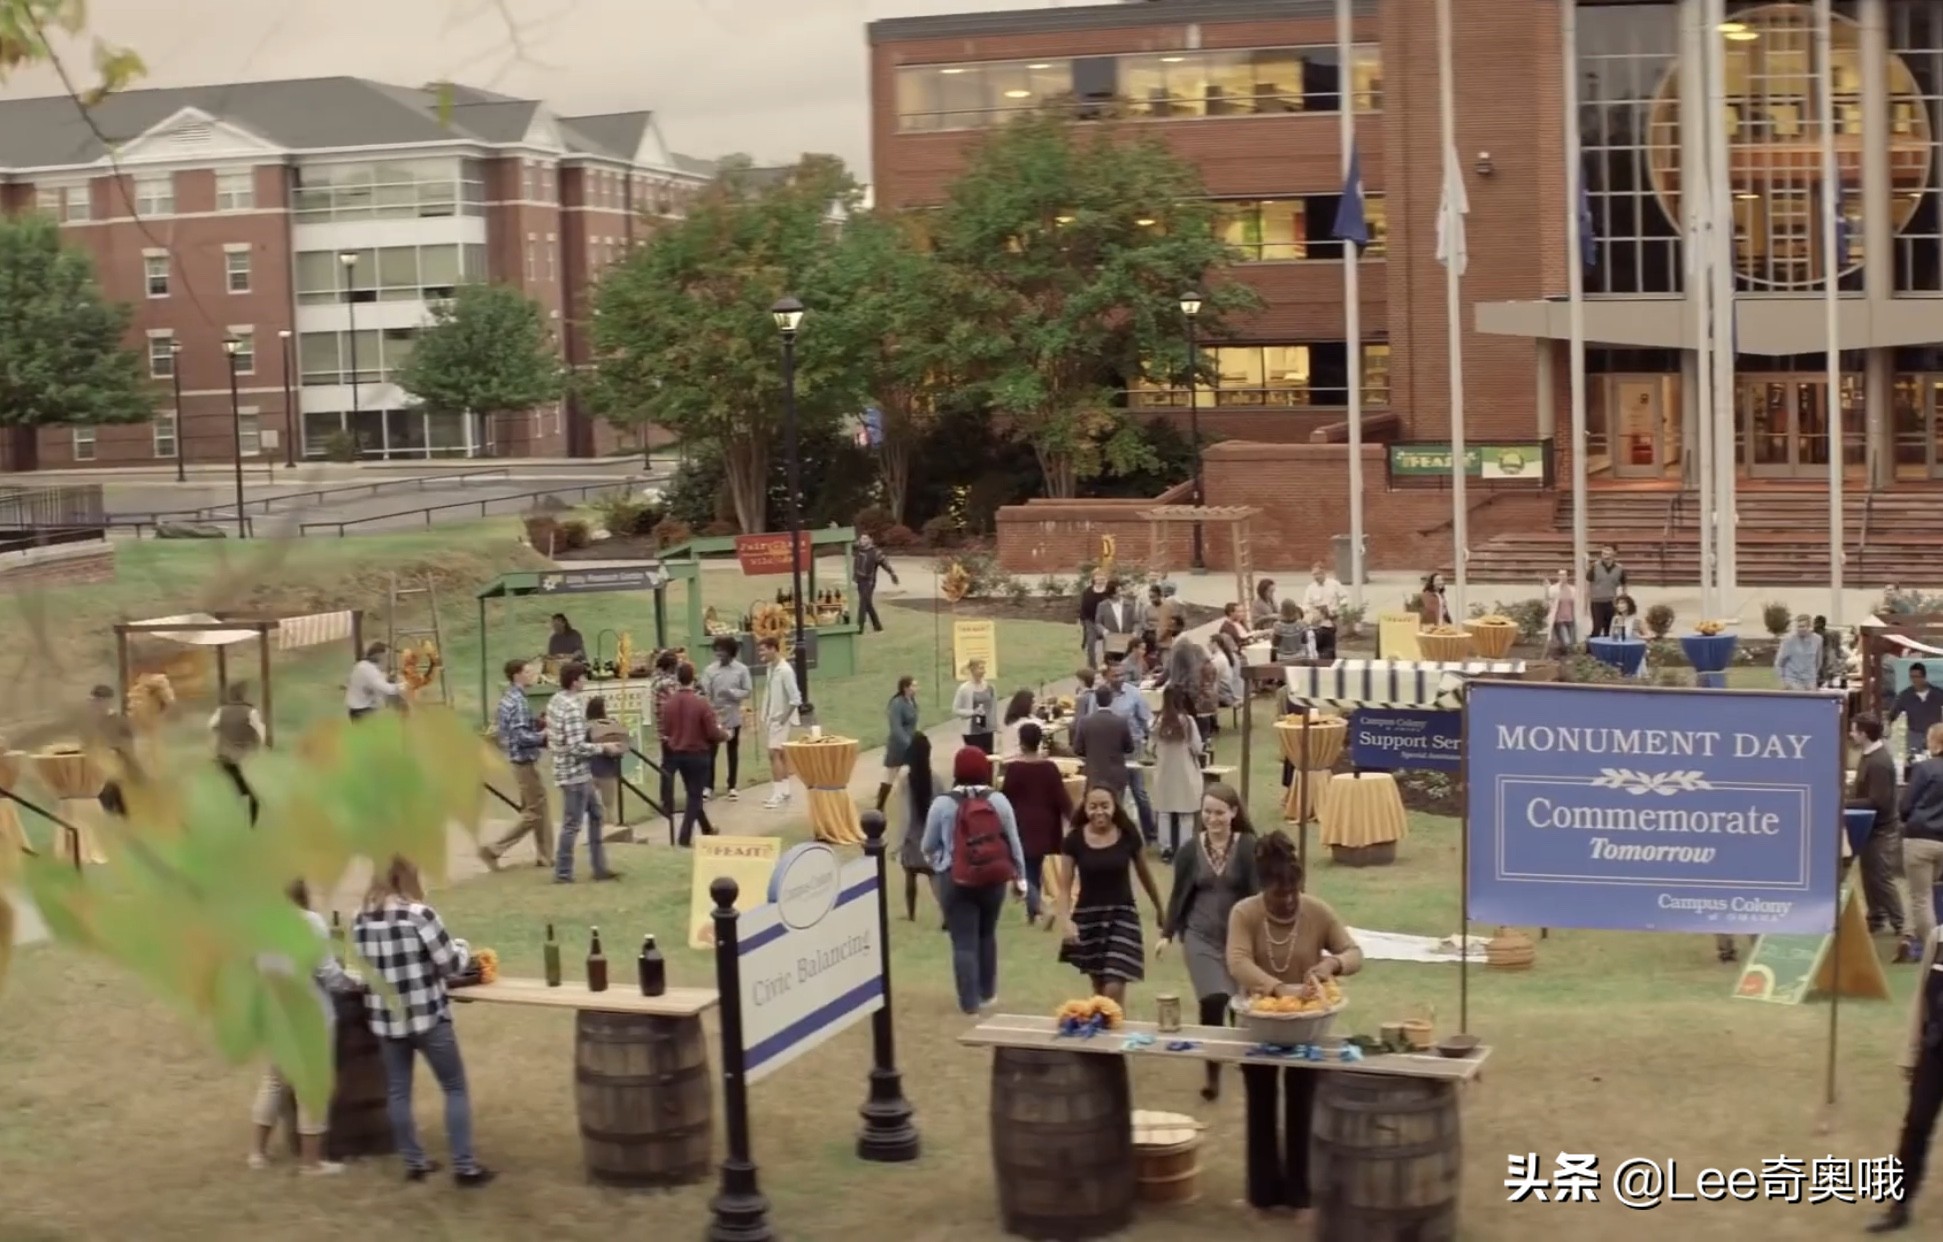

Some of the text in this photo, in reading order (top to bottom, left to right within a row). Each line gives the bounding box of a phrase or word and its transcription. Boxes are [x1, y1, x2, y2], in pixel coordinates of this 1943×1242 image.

[1359, 731, 1428, 750] Support
[1496, 724, 1812, 759] MONUMENT DAY
[1526, 797, 1780, 835] Commemorate
[1589, 837, 1716, 863] Tomorrow
[1658, 893, 1728, 914] Campus
[1730, 896, 1793, 918] Colony
[751, 928, 872, 1007] Civic Balancing
